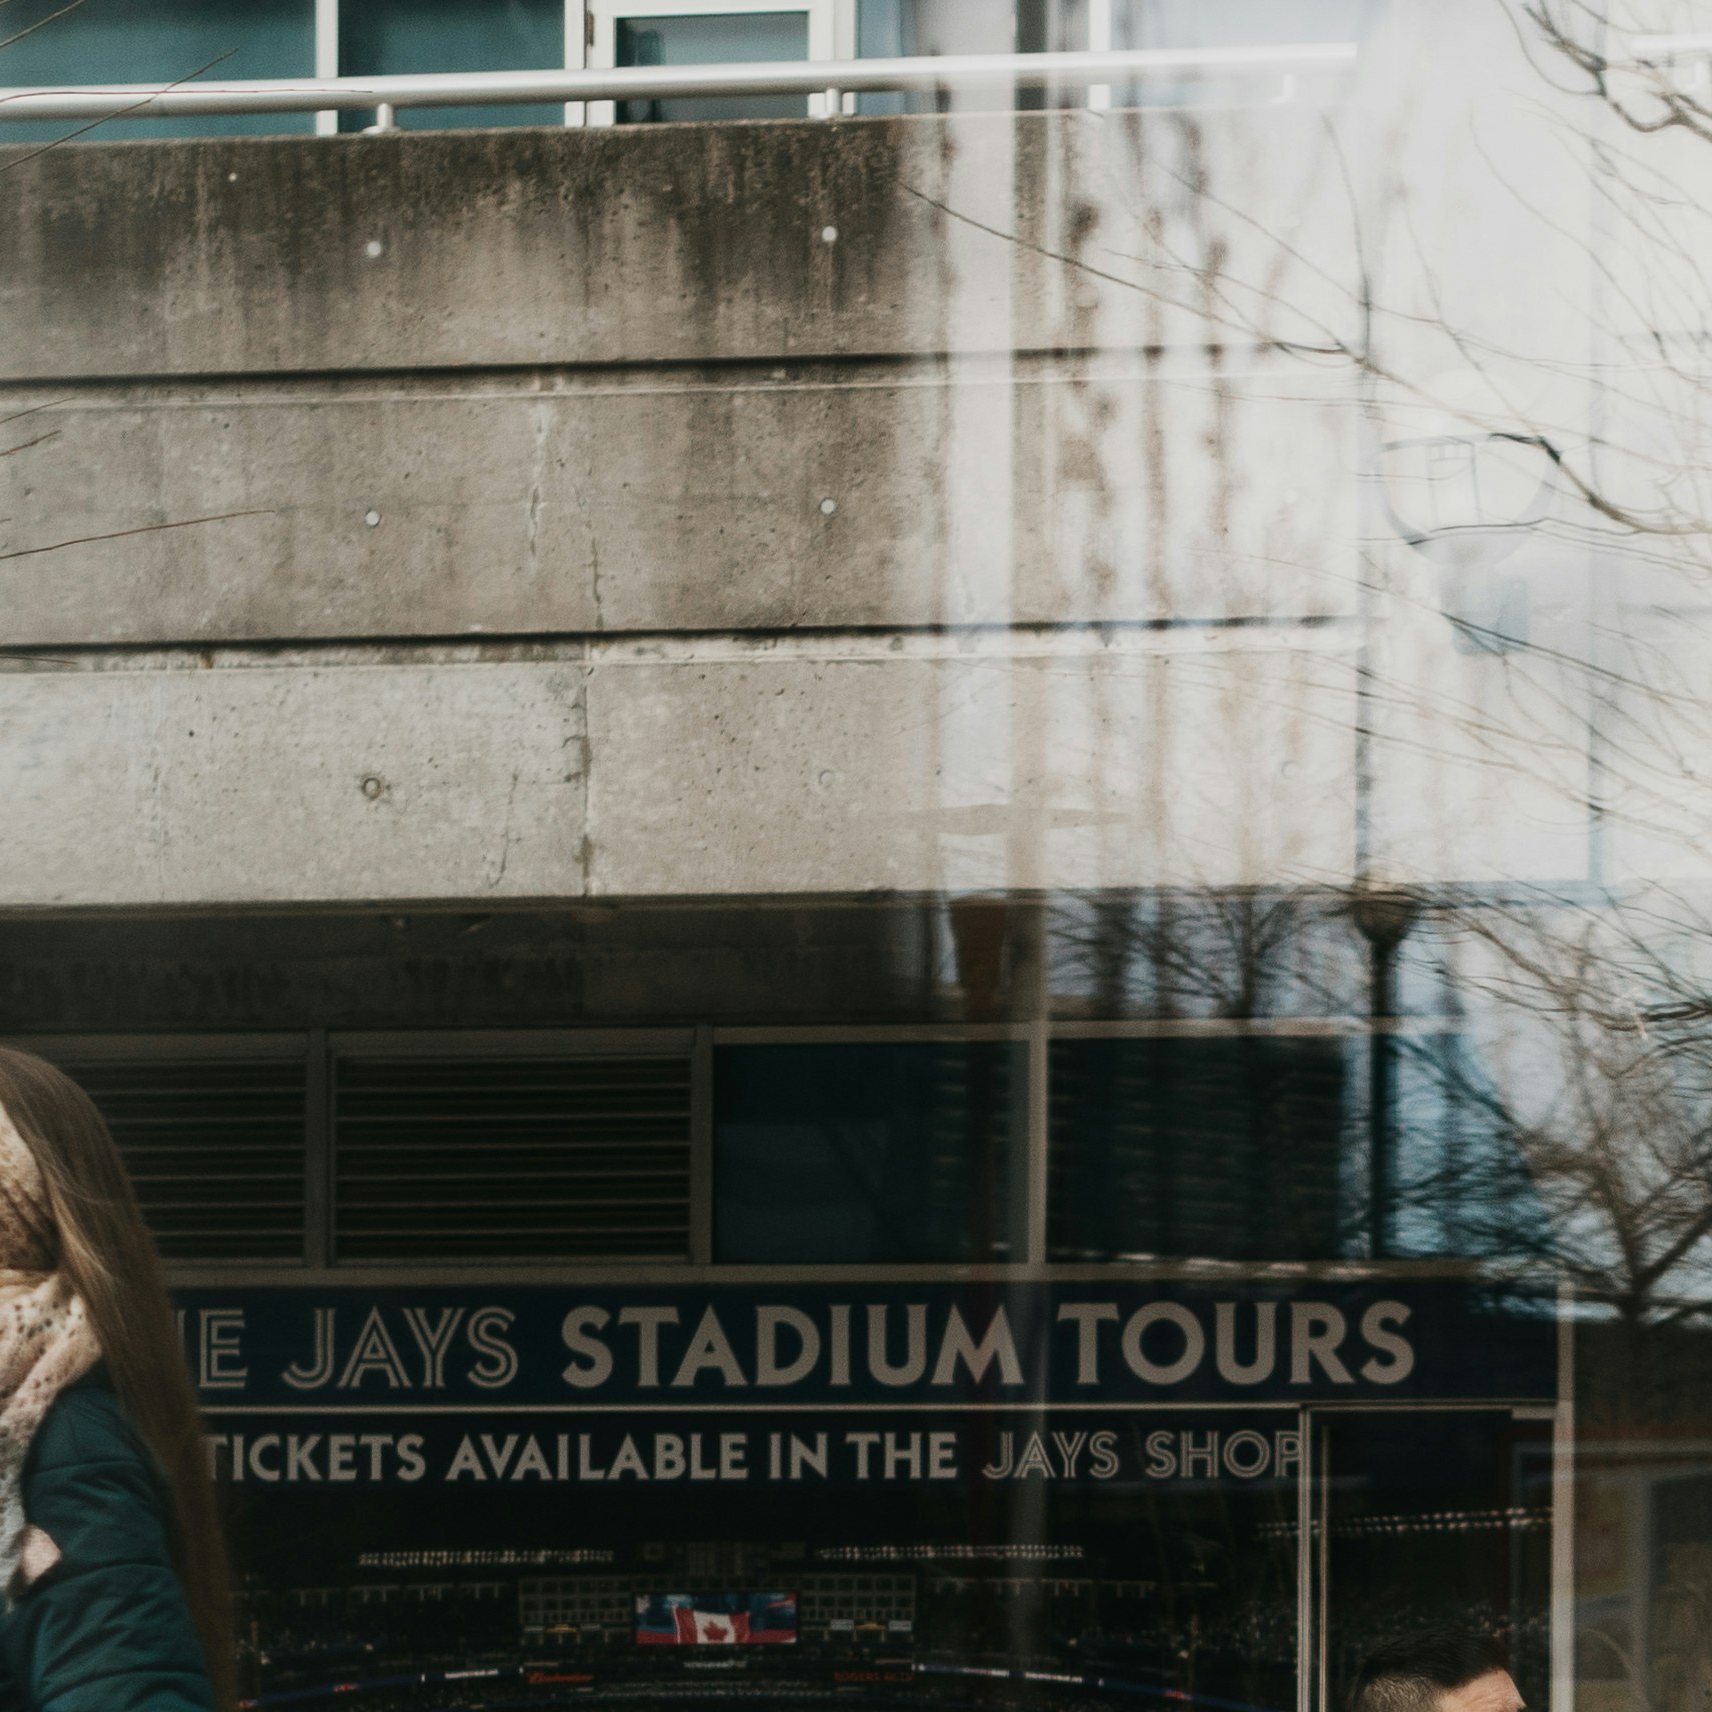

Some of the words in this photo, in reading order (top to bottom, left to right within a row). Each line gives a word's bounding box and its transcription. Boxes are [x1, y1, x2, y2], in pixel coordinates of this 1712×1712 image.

[281, 1305, 519, 1390] JAYS
[561, 1302, 1025, 1388] STADIUM
[1057, 1300, 1415, 1386] TOURS
[199, 1433, 427, 1482] TICKETS
[445, 1432, 749, 1481] AVAILABLE
[769, 1432, 828, 1480] IN
[845, 1431, 958, 1480] THE
[981, 1430, 1120, 1479] JAYS
[1145, 1429, 1303, 1479] SHOP
